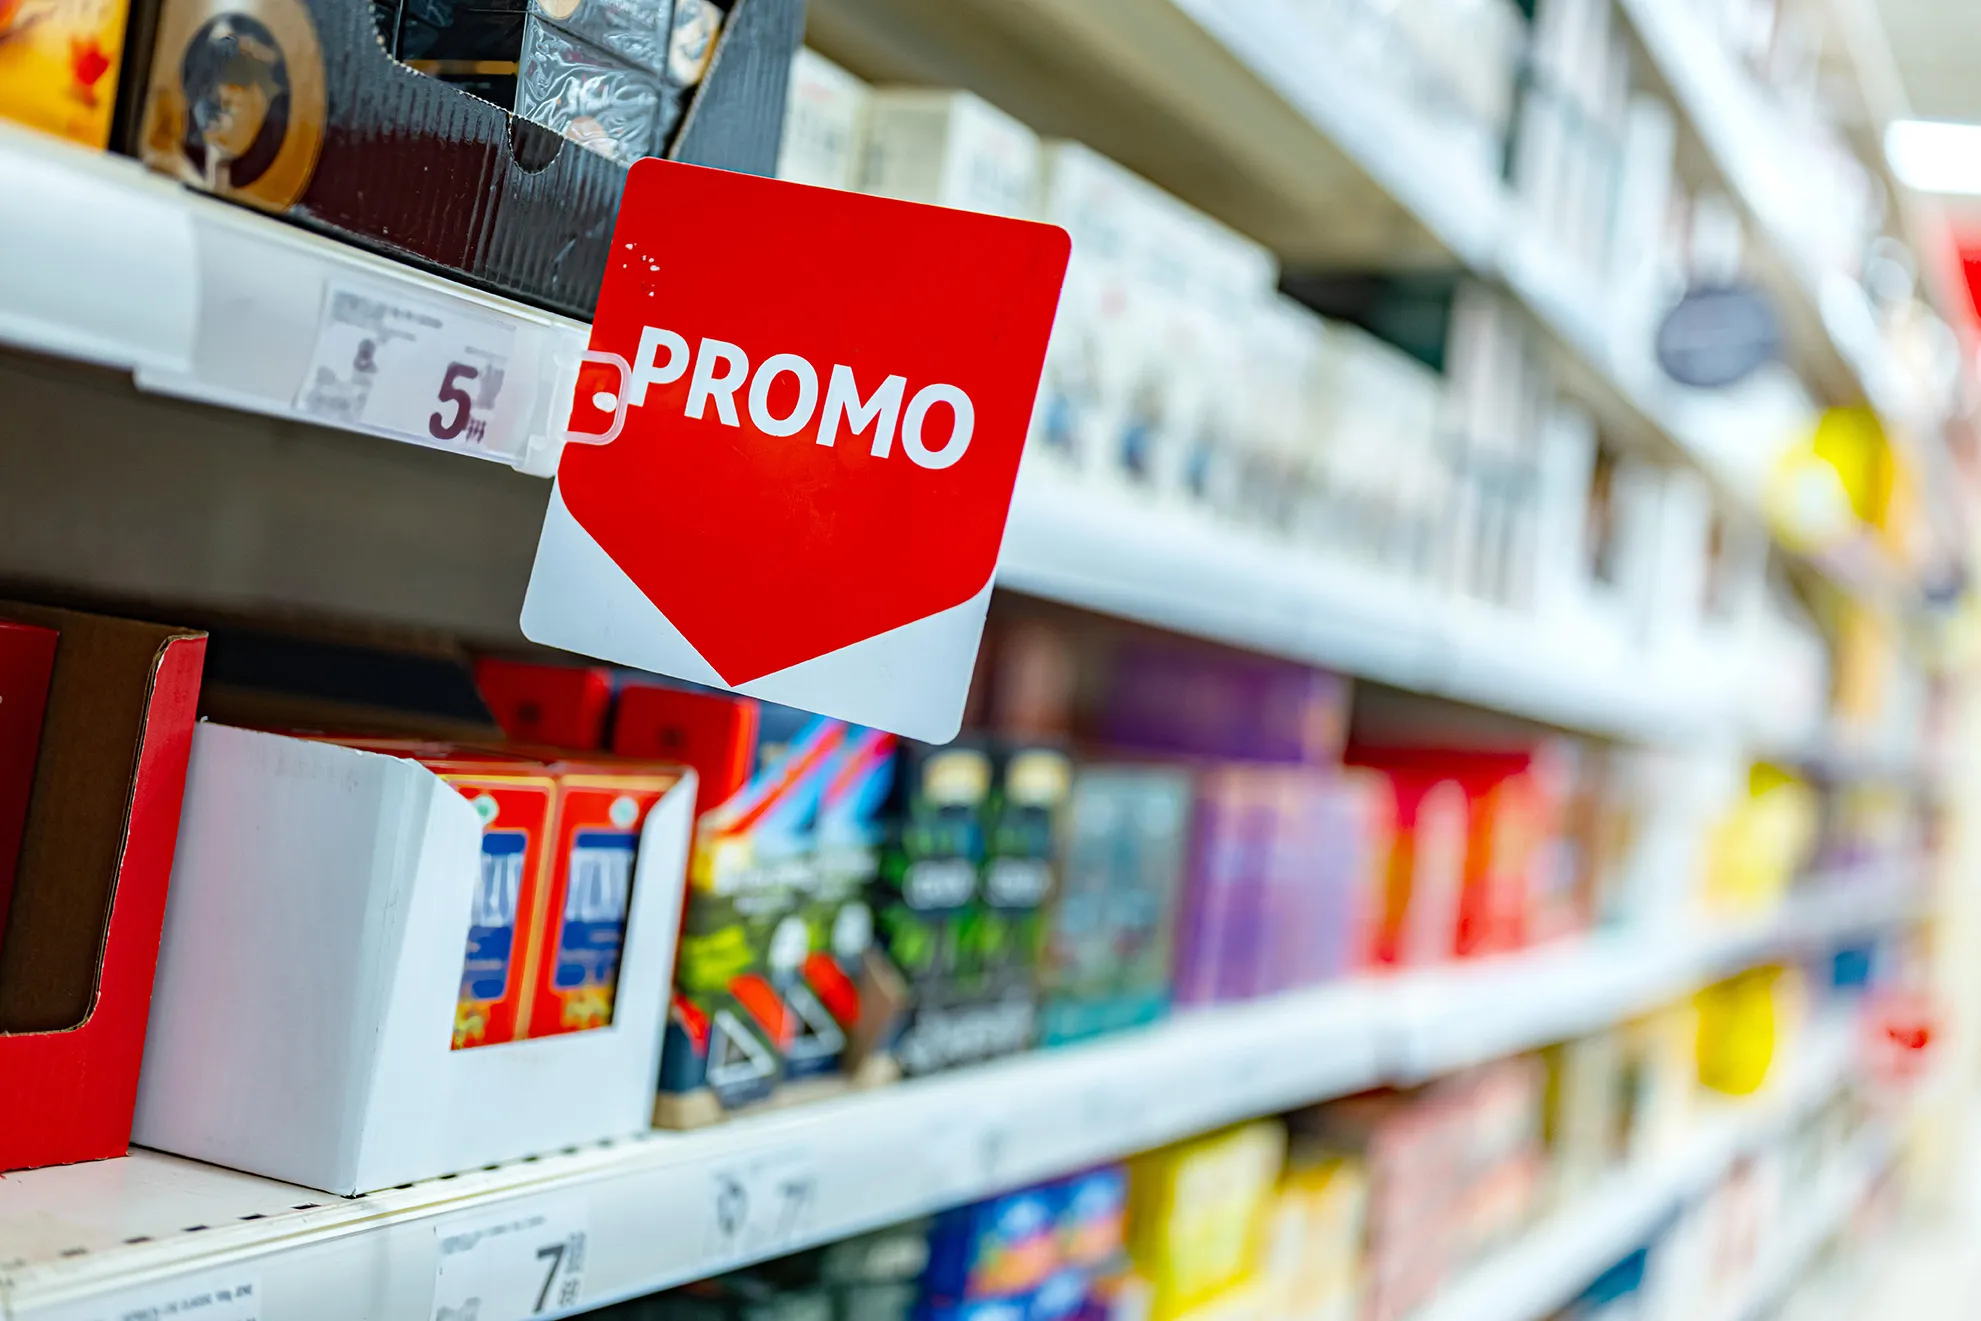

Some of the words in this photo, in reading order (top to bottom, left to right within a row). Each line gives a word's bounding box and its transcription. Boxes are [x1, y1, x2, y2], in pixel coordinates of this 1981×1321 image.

[429, 361, 479, 440] 5
[627, 325, 975, 469] PROMO
[533, 1244, 566, 1313] 7
